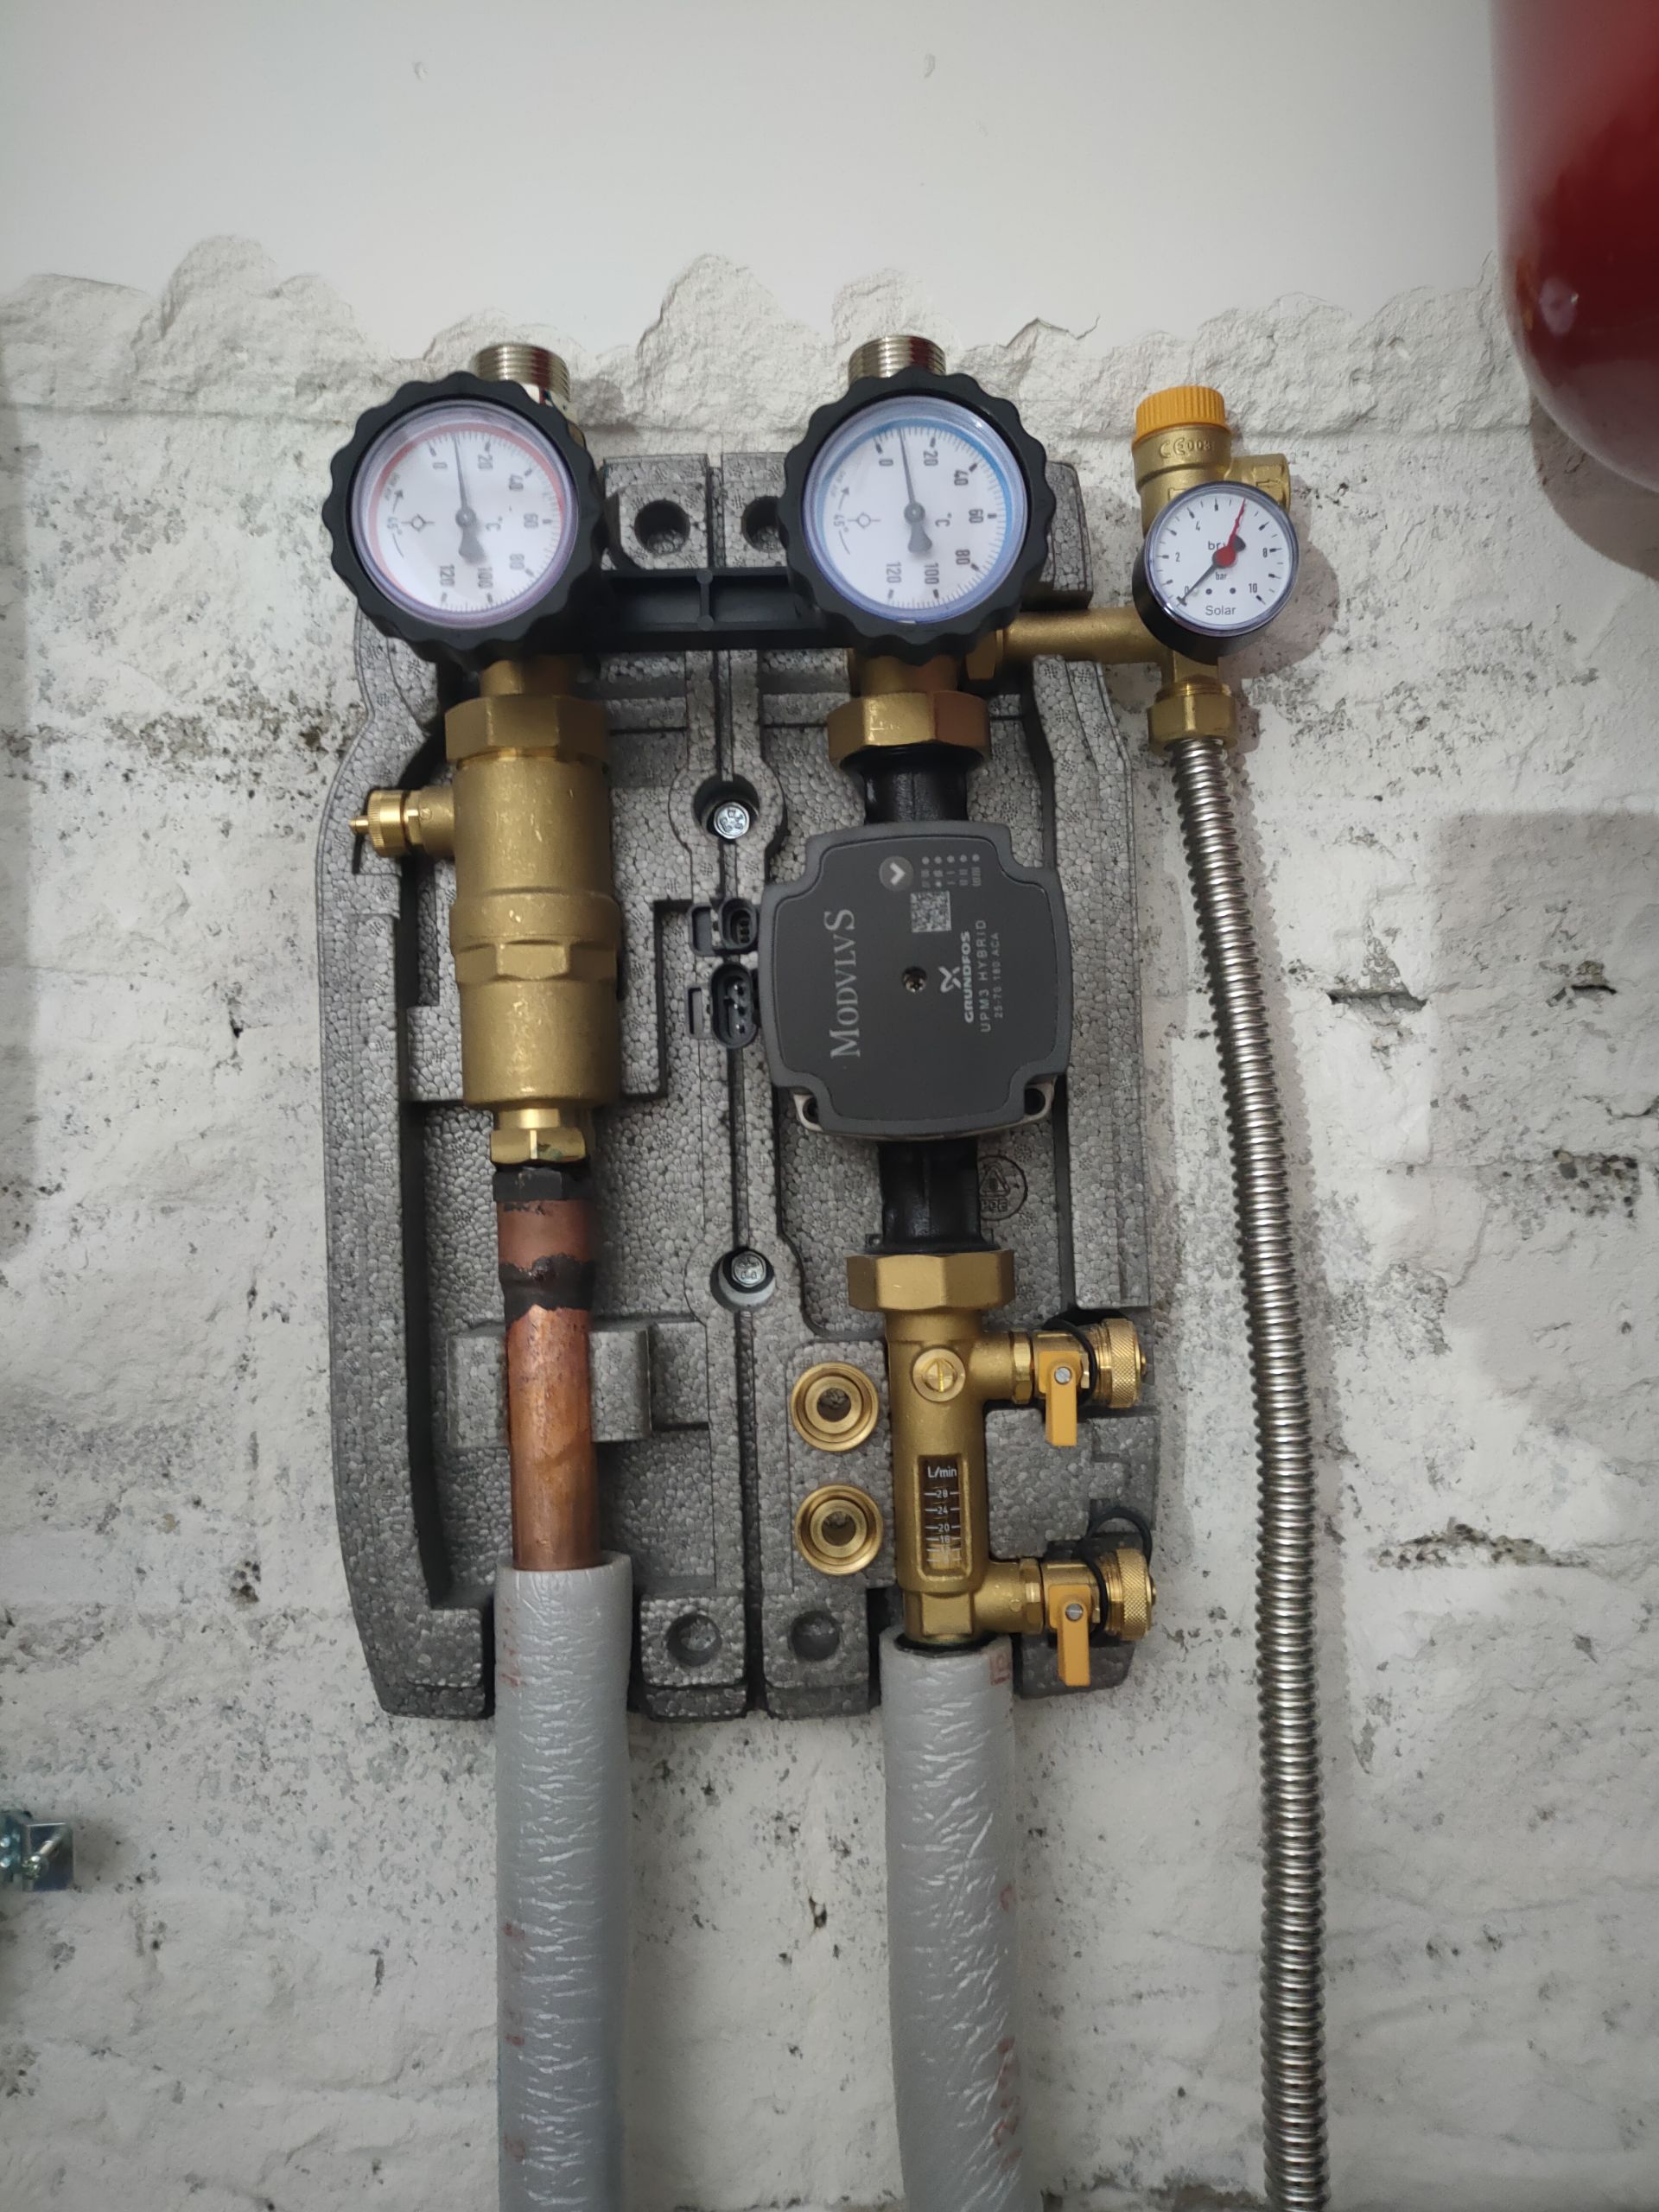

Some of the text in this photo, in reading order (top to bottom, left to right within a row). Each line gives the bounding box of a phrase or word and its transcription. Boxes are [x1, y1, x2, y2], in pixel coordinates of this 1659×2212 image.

[477, 454, 493, 470] 20
[878, 458, 893, 467] 0
[924, 450, 938, 466] 20
[508, 475, 524, 493] 40
[954, 469, 969, 486] 40
[524, 512, 538, 529] 60
[969, 508, 984, 524] 60
[1195, 520, 1201, 531] 4
[955, 549, 970, 565] 80
[1175, 552, 1180, 563] 2
[1262, 547, 1268, 558] 8
[509, 553, 524, 569] 80
[440, 564, 455, 586] 120
[477, 566, 493, 589] 100
[886, 561, 902, 584] 120
[925, 562, 940, 586] 100
[1215, 572, 1228, 581] bar
[1249, 583, 1258, 593] 10
[1205, 605, 1236, 616] Solar
[960, 930, 975, 1024] GRUNDFOS
[975, 919, 992, 1033] UPM3 HYBRID
[927, 1465, 958, 1478] L/min
[936, 1489, 950, 1498] 28
[937, 1506, 950, 1515] 24
[938, 1523, 950, 1533] 20
